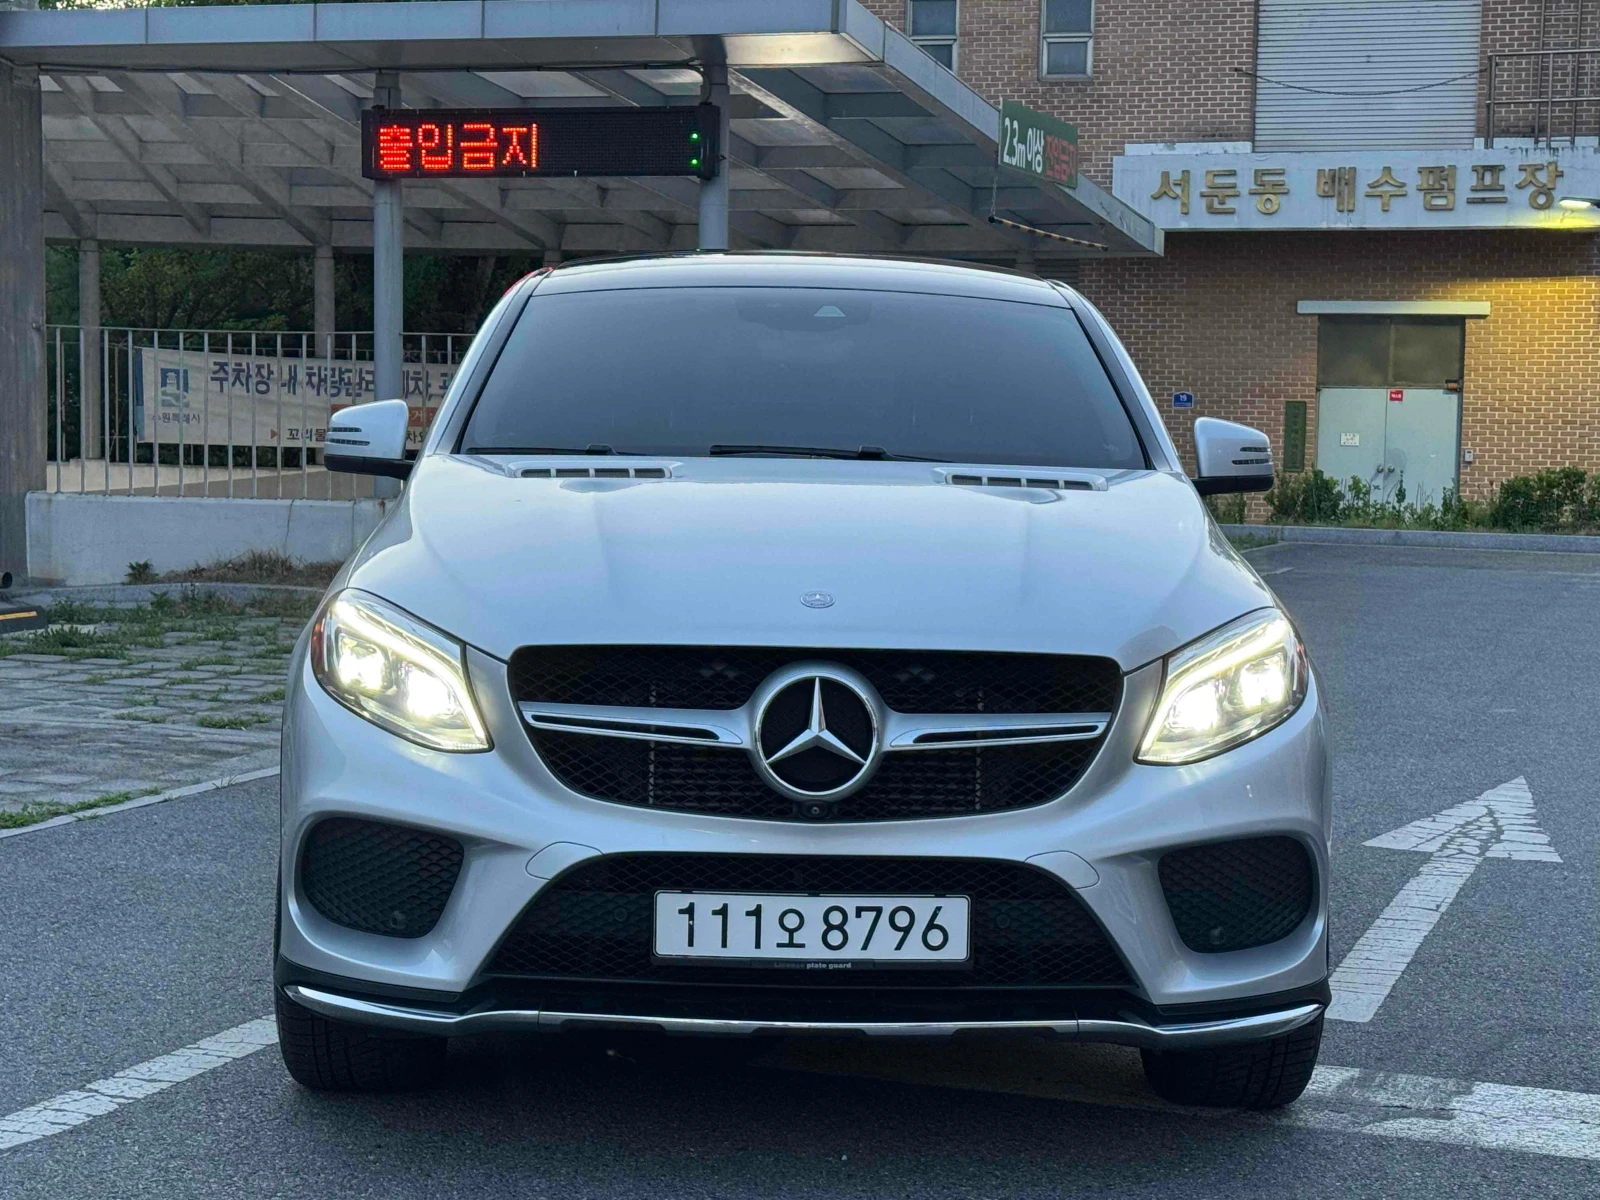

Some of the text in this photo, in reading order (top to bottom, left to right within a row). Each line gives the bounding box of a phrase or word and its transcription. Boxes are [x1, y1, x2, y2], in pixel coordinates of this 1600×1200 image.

[380, 124, 538, 169] 출입금지
[1151, 161, 1564, 215] 서둔동 배수펌프장
[210, 361, 274, 395] 주차장
[806, 962, 827, 970] plate
[828, 962, 852, 970] guard
